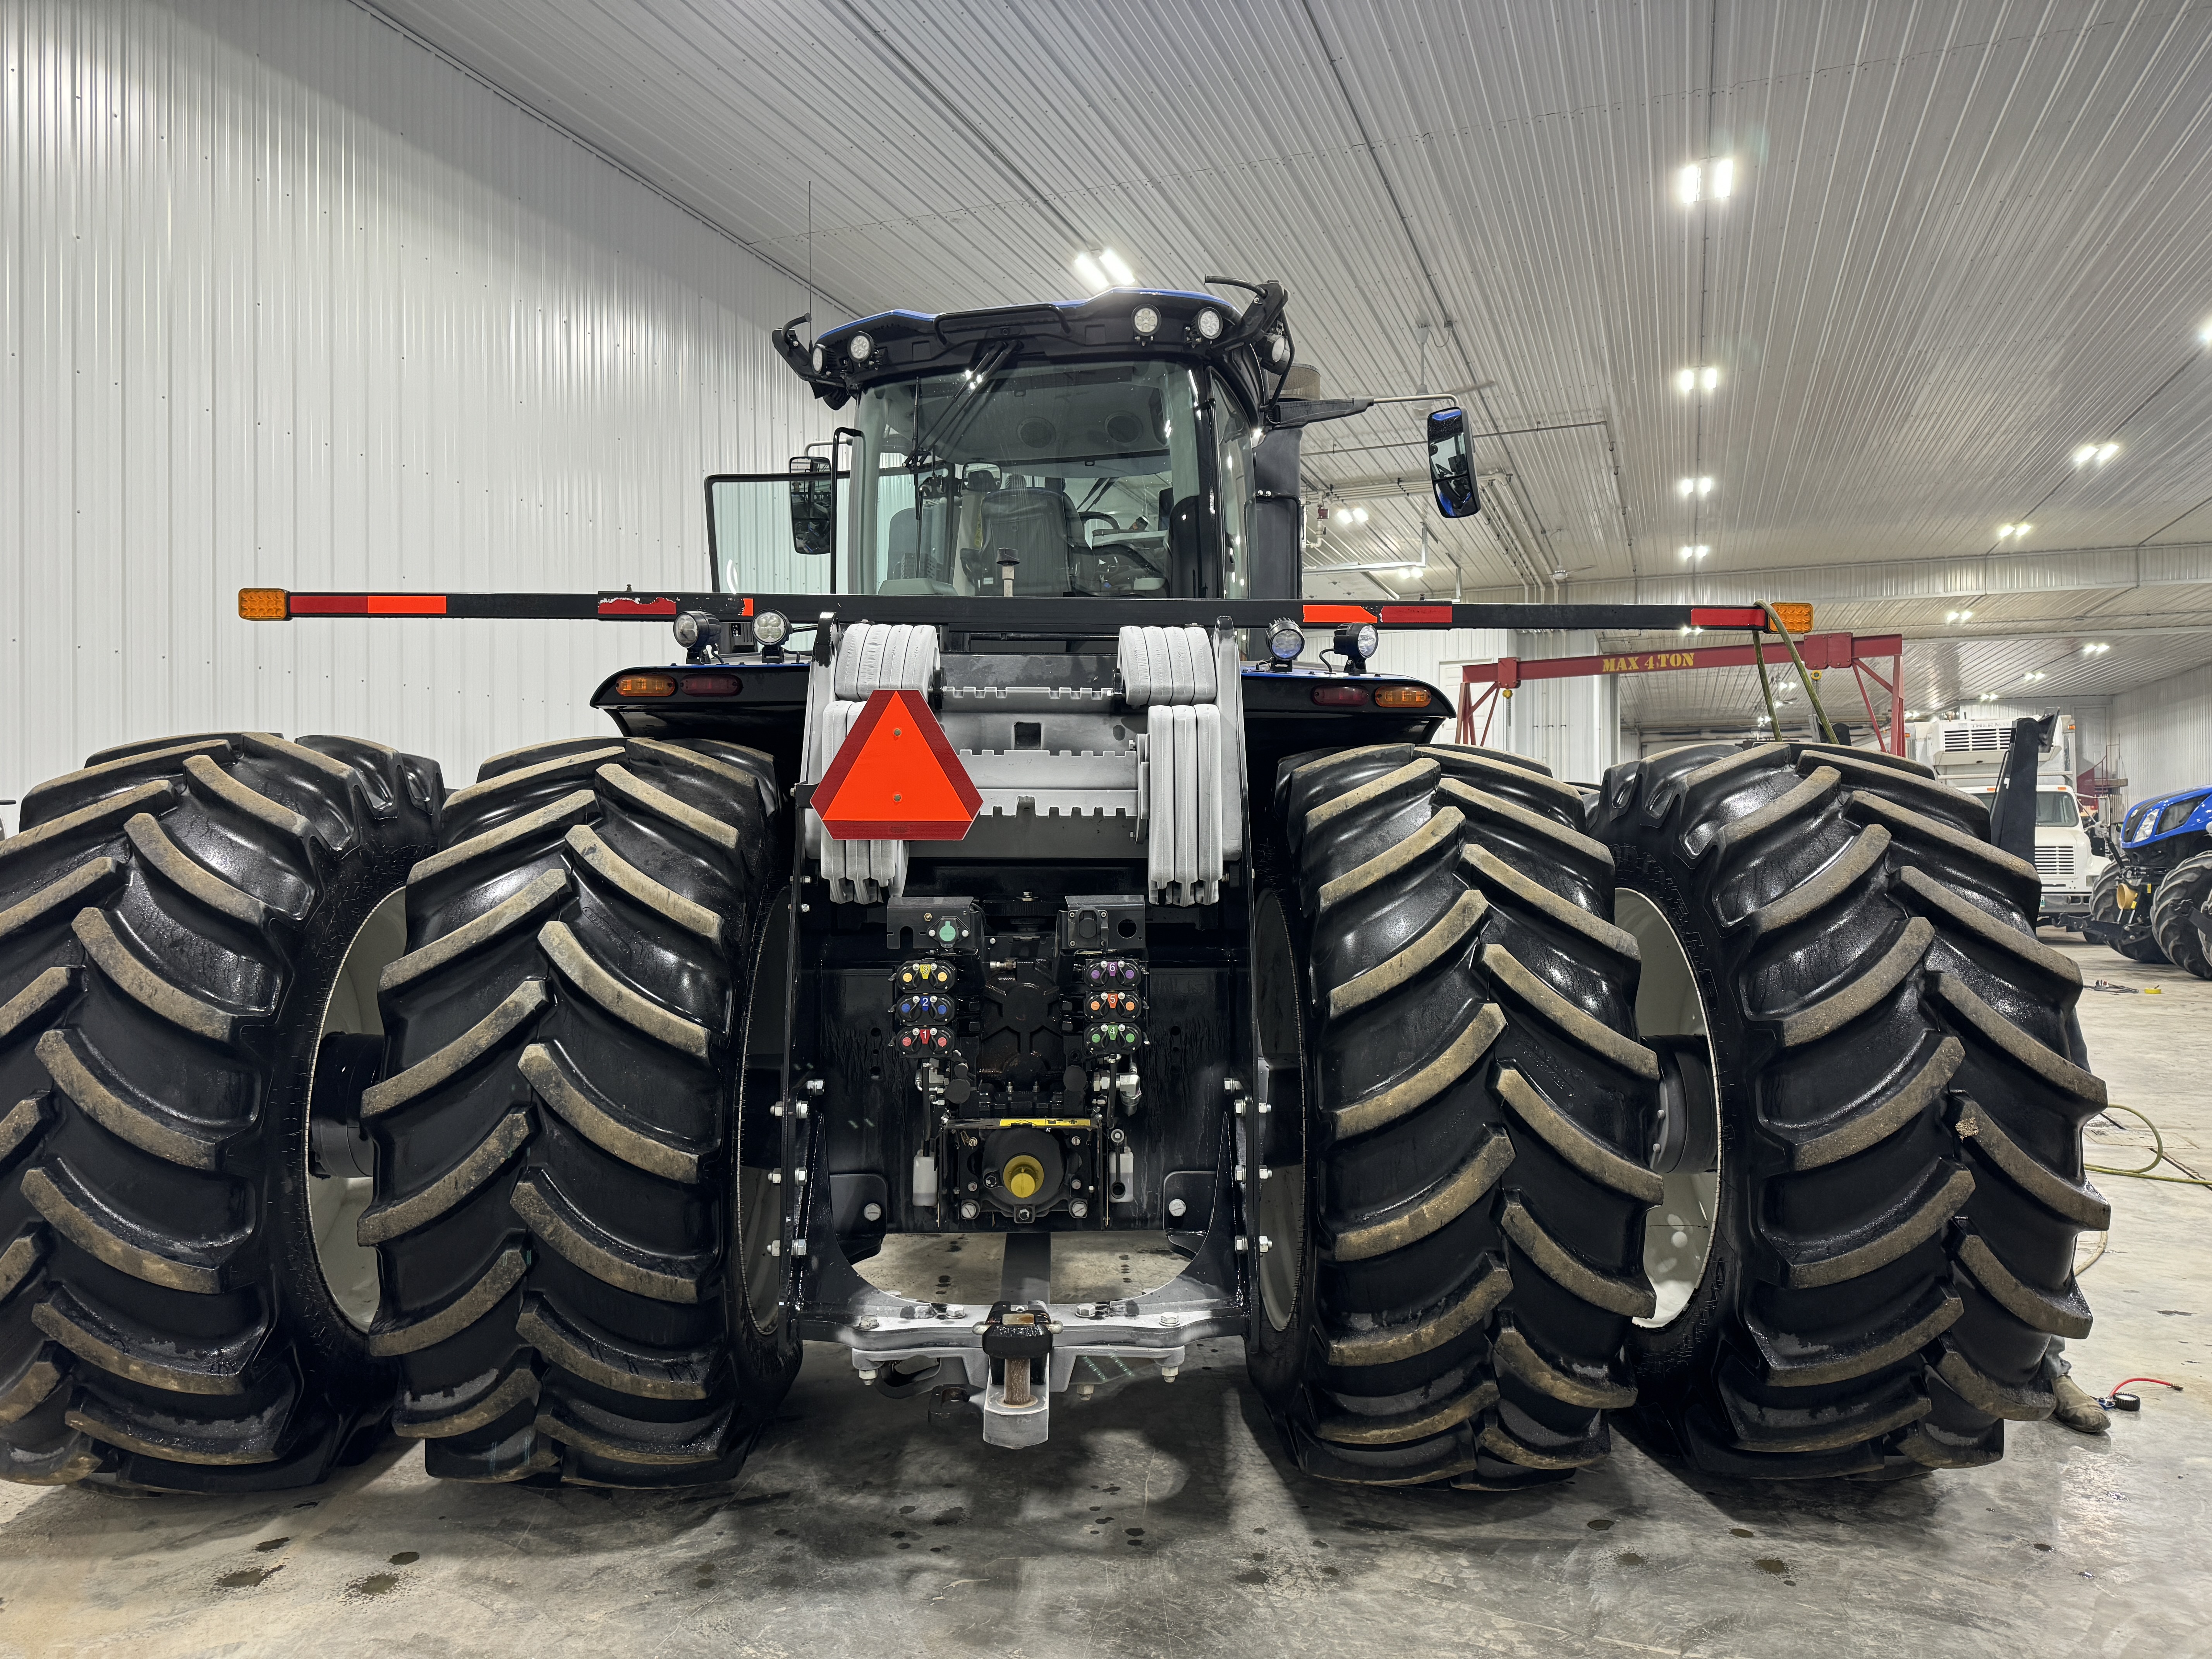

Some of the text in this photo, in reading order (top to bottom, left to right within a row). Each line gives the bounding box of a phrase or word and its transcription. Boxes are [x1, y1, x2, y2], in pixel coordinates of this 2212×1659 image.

[1602, 652, 1695, 672] MAX 4 TON
[922, 965, 928, 974] 3
[1109, 963, 1116, 972] 6
[922, 997, 929, 1006] 2
[1110, 994, 1116, 1003] 5
[922, 1030, 927, 1039] 1
[1109, 1026, 1116, 1035] 4
